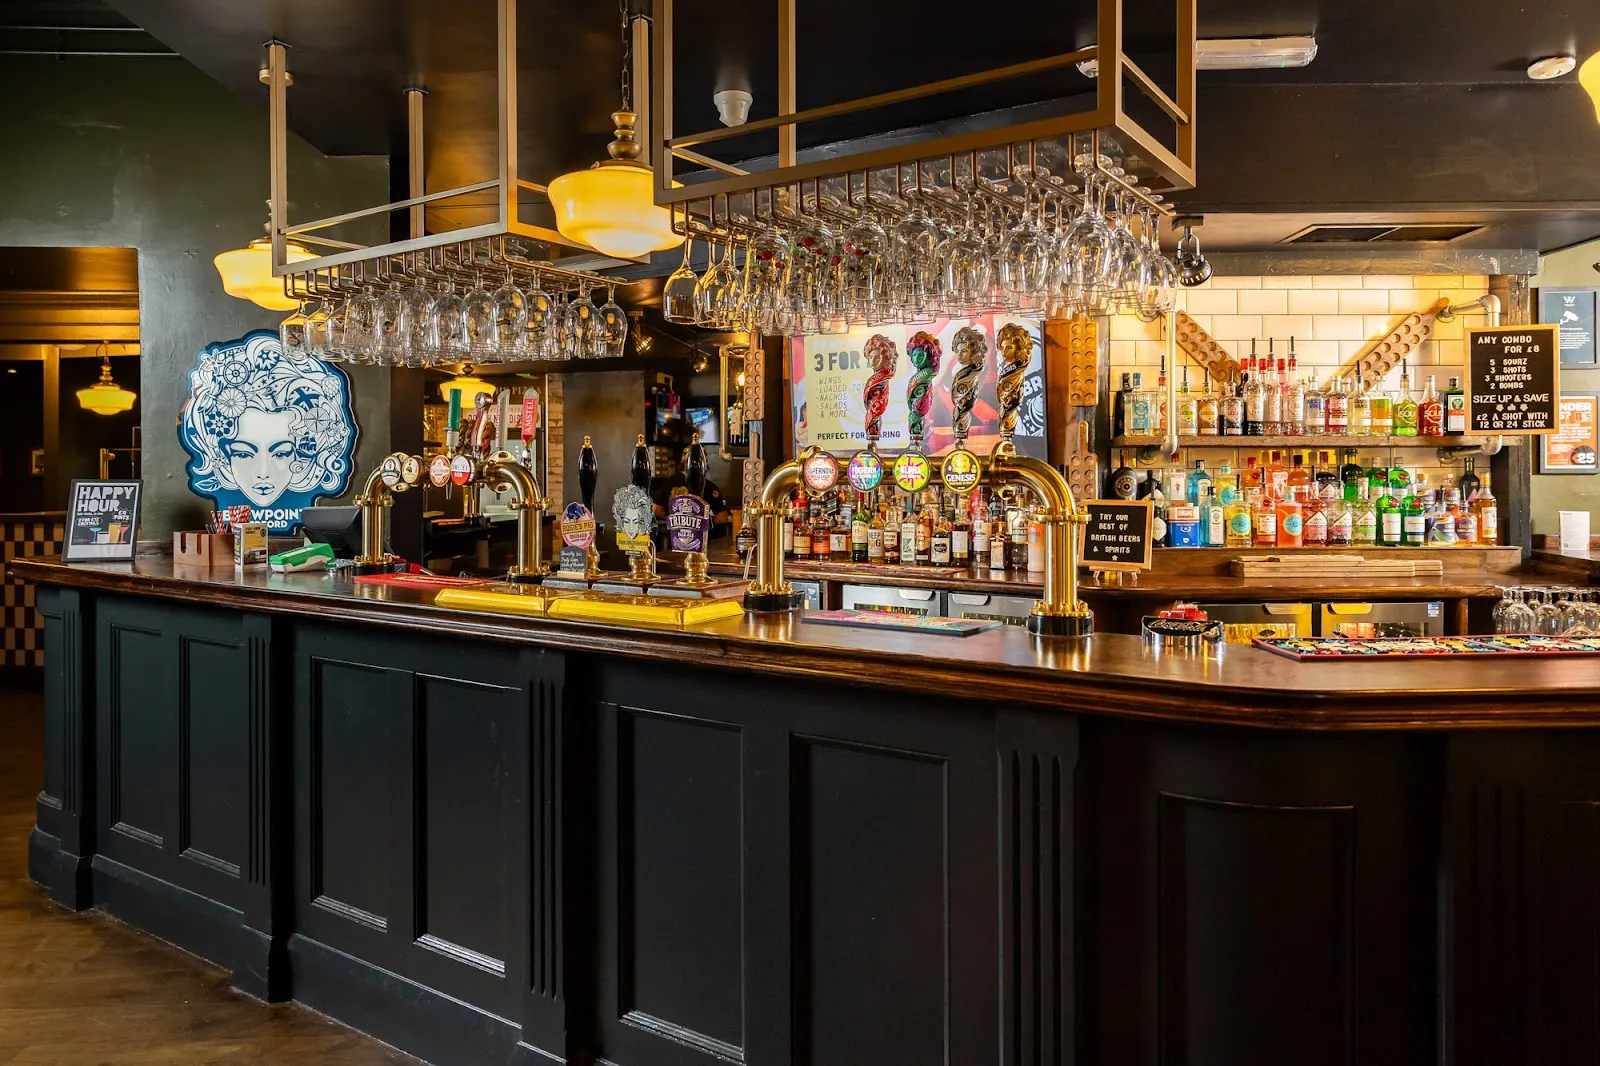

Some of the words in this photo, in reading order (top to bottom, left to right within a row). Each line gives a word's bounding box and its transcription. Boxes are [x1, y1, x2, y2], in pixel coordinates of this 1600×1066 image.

[1478, 336, 1497, 344] ANY
[1502, 335, 1532, 344] COMBO
[814, 353, 824, 372] 3
[828, 350, 860, 371] FOR
[1490, 382, 1496, 390] 2
[1473, 394, 1497, 404] SIZE
[1498, 394, 1512, 403] UP
[1514, 394, 1521, 402] &
[1523, 393, 1549, 402] SAVE
[1560, 402, 1593, 412] NDER
[524, 400, 535, 433] AMSTEL
[829, 410, 848, 418] MORE
[1476, 413, 1488, 421] £2
[1502, 412, 1523, 420] SHOT
[1527, 412, 1548, 420] WITH
[1522, 420, 1546, 428] STICK
[817, 432, 849, 440] PERFECT
[851, 431, 865, 439] FOR
[946, 473, 976, 482] GENESIS
[79, 486, 135, 500] HAPPY
[77, 499, 121, 512] HOUR
[222, 508, 303, 521] BWPOIN
[1099, 513, 1113, 521] TRY
[562, 523, 583, 532] ROSIE'S
[584, 521, 594, 529] PIG
[668, 515, 702, 529] TRIBUTE
[1098, 522, 1116, 530] BEST
[1118, 523, 1129, 531] OF
[1090, 534, 1117, 542] BRITISH
[1118, 535, 1141, 543] BEERS
[1104, 546, 1131, 554] SPIRITS
